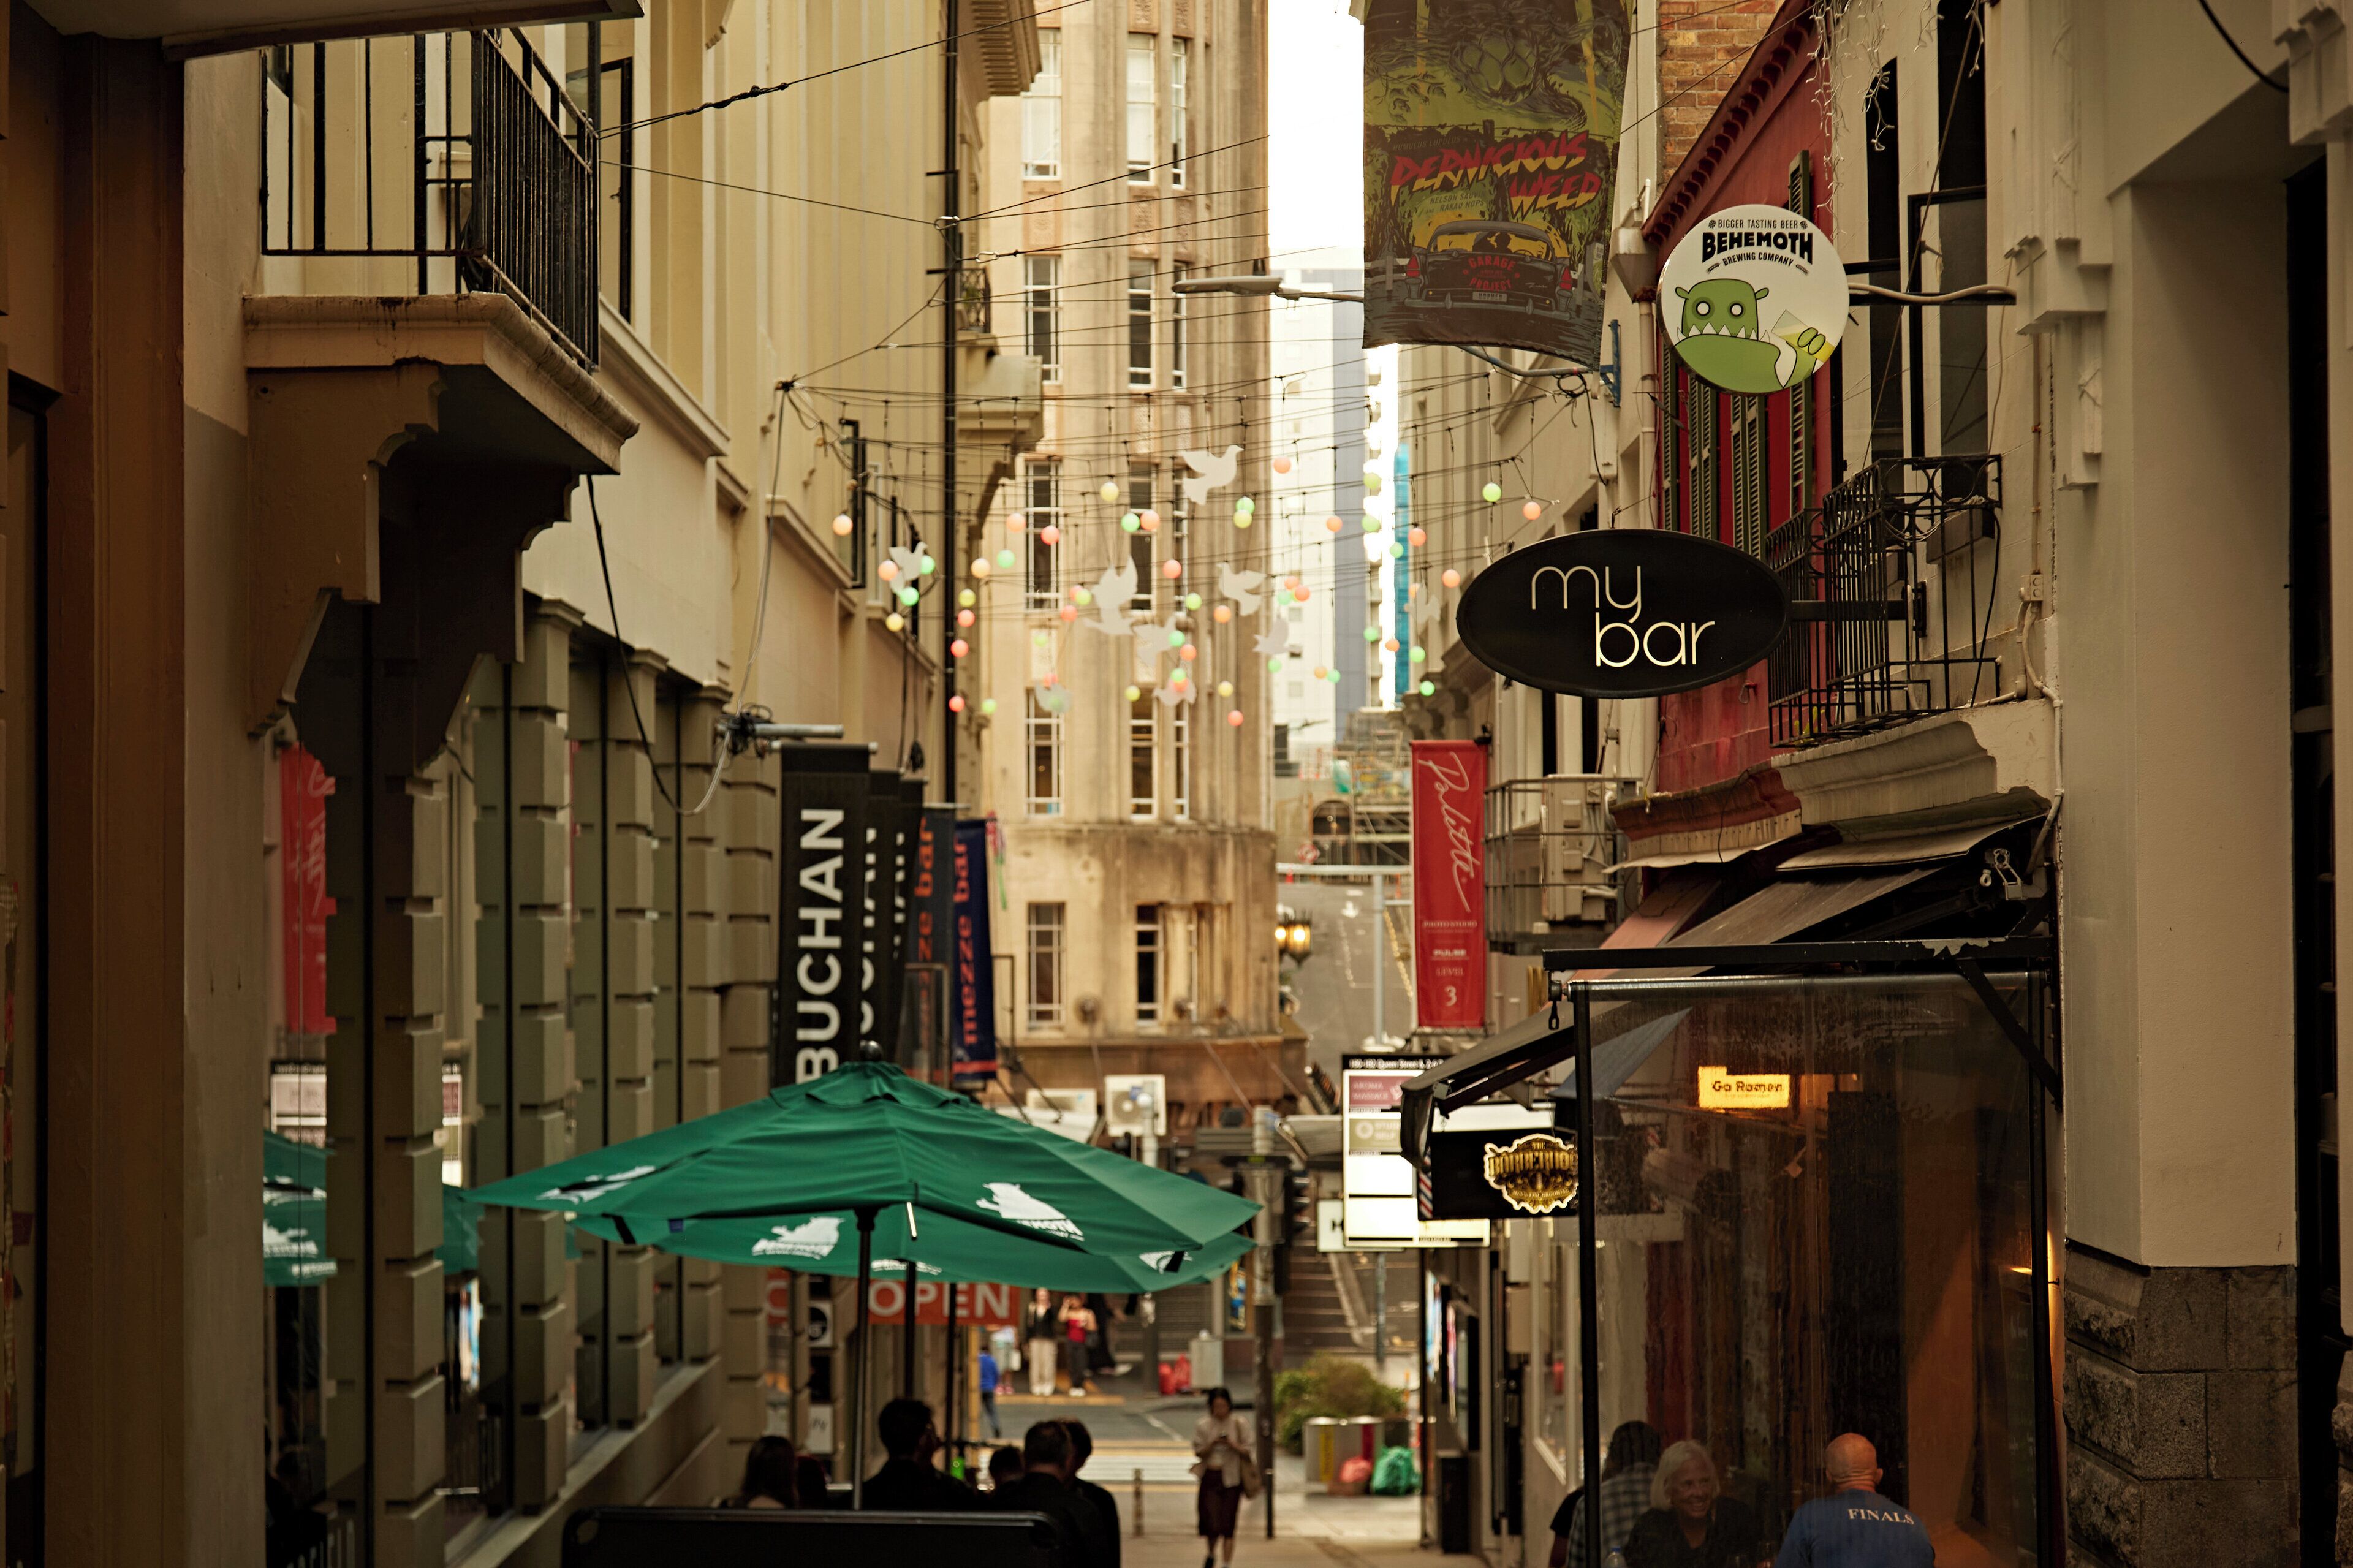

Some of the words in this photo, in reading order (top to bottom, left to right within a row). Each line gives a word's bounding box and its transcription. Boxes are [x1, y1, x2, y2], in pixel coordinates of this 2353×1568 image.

[1390, 130, 1589, 207] PERNICIOUS
[1430, 194, 1458, 204] NELSON
[1440, 202, 1463, 211] RAKAU
[1465, 200, 1485, 208] HOPS
[1509, 171, 1603, 221] WEED
[1718, 219, 1744, 229] BIGGER
[1748, 219, 1777, 229] TASTING
[1781, 220, 1798, 229] BEER
[1702, 232, 1813, 265] BEHEMOTH
[1722, 252, 1756, 267] BREWING
[1758, 252, 1794, 267] COMPANY
[1468, 254, 1517, 271] GARAGE
[1469, 276, 1512, 293] PROJECT
[1532, 566, 1642, 623] my
[1596, 612, 1715, 667] bar
[953, 834, 970, 903] bar
[796, 809, 844, 1085] BUCHAN
[958, 915, 978, 1044] mezze
[1436, 967, 1464, 976] LEVEL
[1444, 985, 1457, 1007] 3
[1531, 1142, 1546, 1150] THE
[1488, 1150, 1578, 1178] BARBERHO
[868, 1279, 1010, 1319] OPEN
[1848, 1509, 1914, 1525] FINALS
